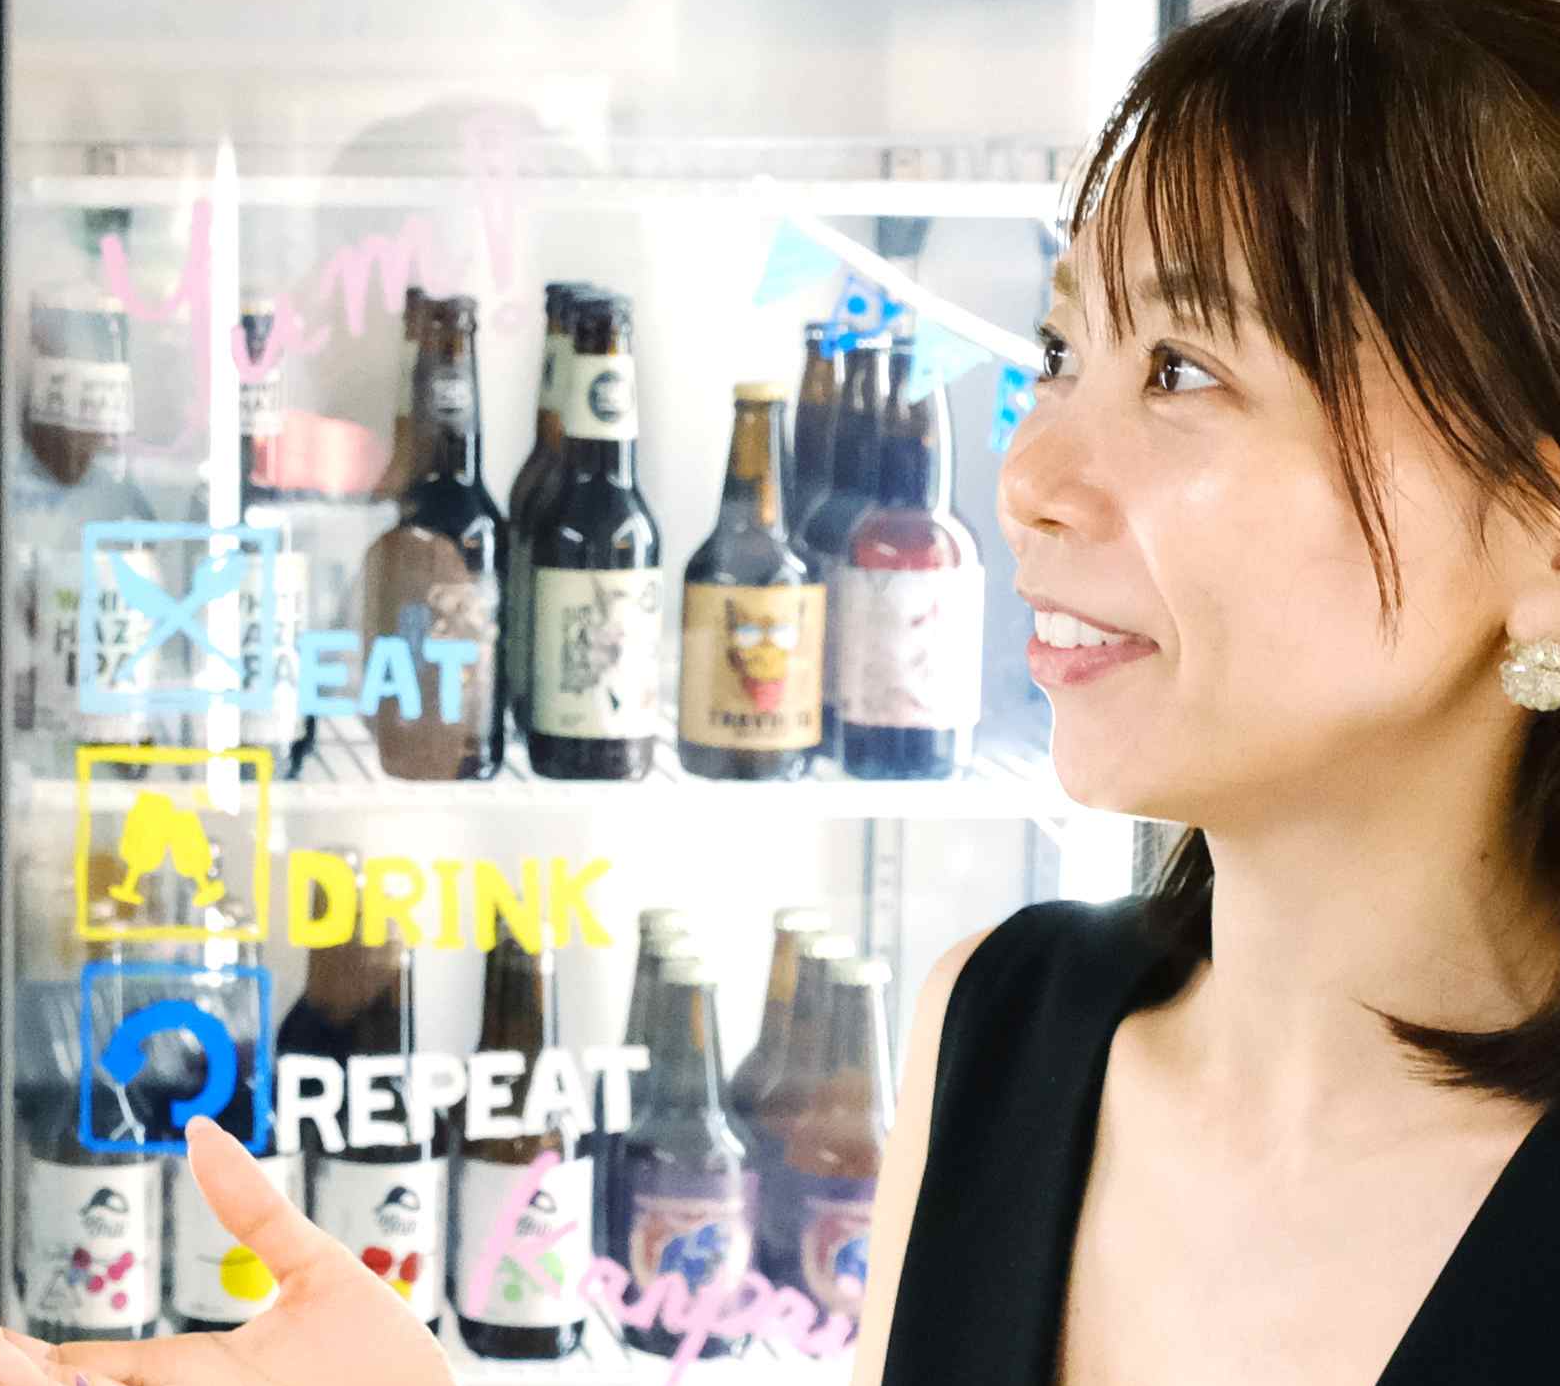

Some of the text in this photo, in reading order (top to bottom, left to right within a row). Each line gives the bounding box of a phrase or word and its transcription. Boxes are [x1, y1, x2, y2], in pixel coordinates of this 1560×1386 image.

[297, 629, 481, 725] EAT
[285, 847, 616, 956] DRINK
[277, 1043, 651, 1156] REPEAT
